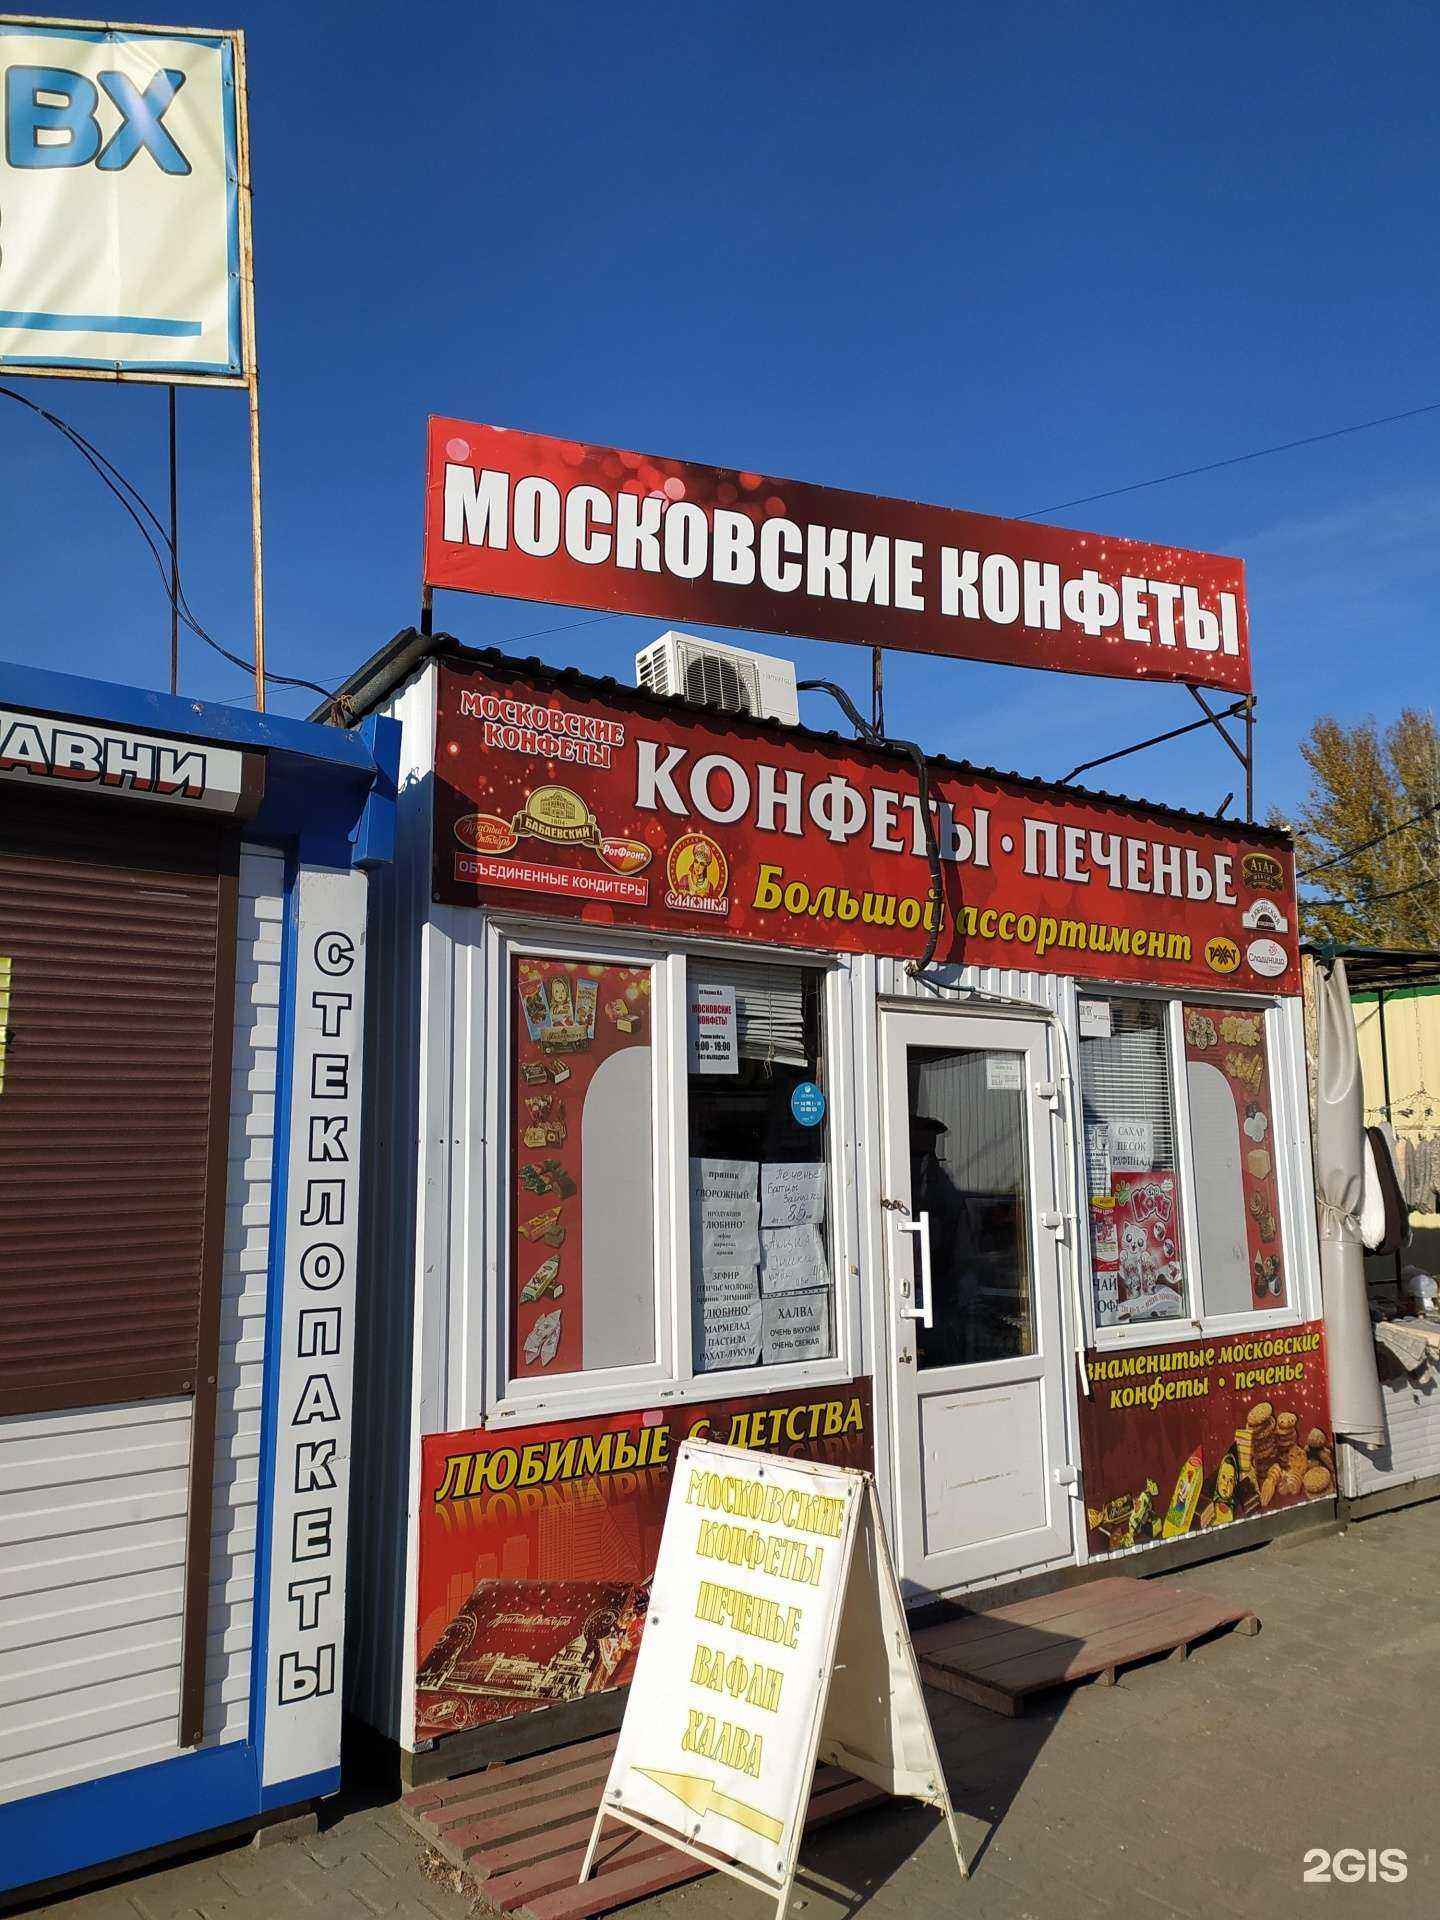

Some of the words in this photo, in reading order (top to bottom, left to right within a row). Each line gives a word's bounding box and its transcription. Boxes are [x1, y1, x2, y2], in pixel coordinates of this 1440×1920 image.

[442, 462, 925, 612] МОСКОВСКИЕ
[941, 545, 1240, 656] КОНФЕТЫ
[460, 690, 625, 747] МОСКОВСКИЕ
[484, 722, 611, 769] КОНФЕТЫ
[525, 818, 590, 841] БАБАЕВСКИЙ
[635, 739, 991, 867] КОНФЕТЫ
[1023, 818, 1238, 906] ПЕЧЕНЬЕ
[459, 860, 569, 886] ОБЪЕДИНЕННЫЕ
[572, 876, 646, 897] КОНДИТЕРЫ
[666, 893, 727, 912] СЛАВЯНКА
[752, 863, 945, 932] Большой
[957, 905, 1193, 962] ассортимент
[691, 1003, 732, 1015] МОСКОВСКИЕ
[698, 1014, 728, 1026] КОНФЕТЫ
[1116, 1141, 1147, 1152] ПЕСОК
[1117, 1126, 1145, 1137] САХАР
[713, 1271, 740, 1280] ЗЕФИР
[278, 930, 355, 1706] СТЕКЛОПАКЕТЫ
[704, 1321, 750, 1334] МАРМЕЛАД
[778, 1305, 814, 1319] ХАЛВА
[1218, 1333, 1321, 1364] московские
[1110, 1375, 1209, 1411] конфеты
[1235, 1361, 1304, 1390] печенье
[435, 1425, 671, 1502] ЛЮБИМЫЕ
[727, 1397, 865, 1450] ДЕТСТВА
[685, 1468, 846, 1539] МОСКОВСКИЕ
[696, 1518, 825, 1586] КОНФЕТЫ
[695, 1580, 803, 1650] ПЕЧЕНЬЕ
[690, 1643, 784, 1713] ВАФЛИ
[681, 1709, 764, 1780] ХАЛВА
